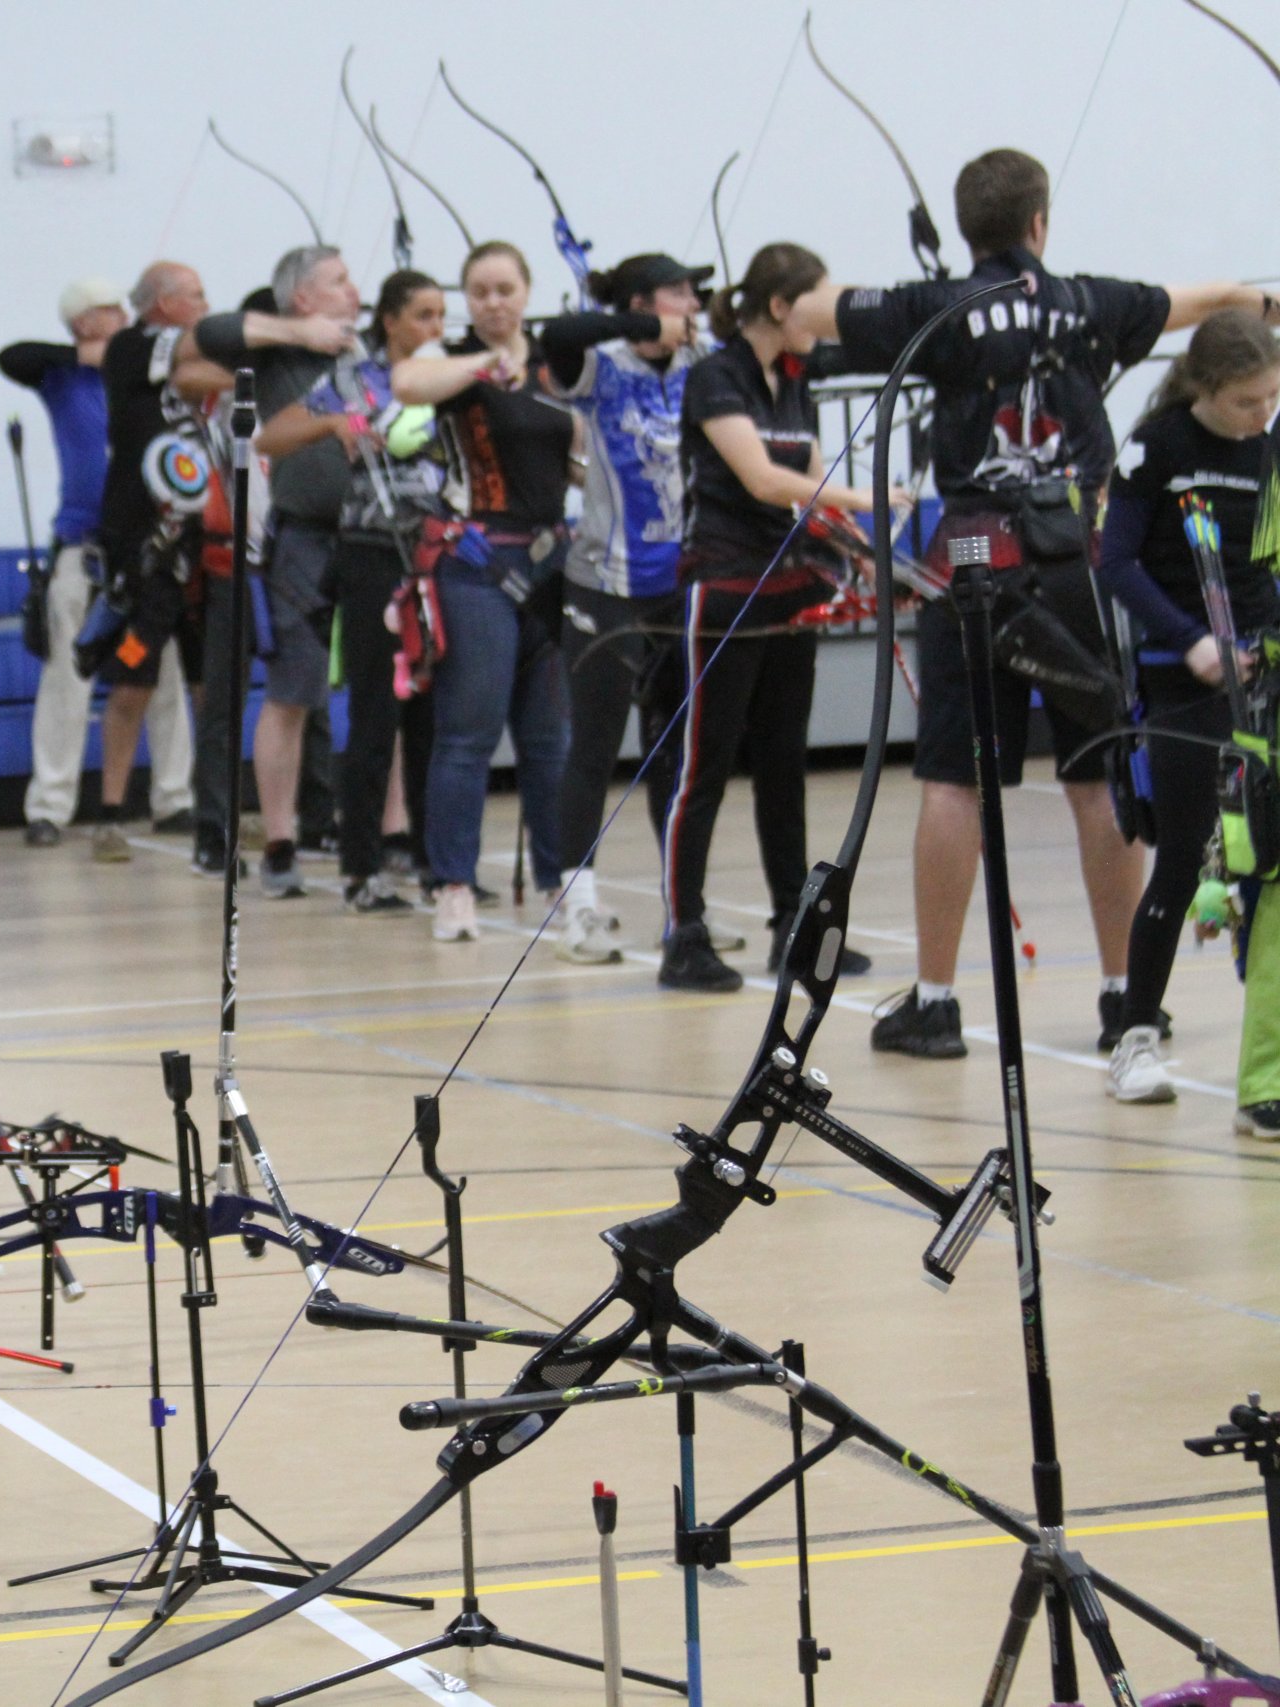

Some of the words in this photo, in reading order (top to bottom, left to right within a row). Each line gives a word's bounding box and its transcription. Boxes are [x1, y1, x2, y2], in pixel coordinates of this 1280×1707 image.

[767, 1086, 790, 1105] THE
[794, 1105, 838, 1137] SYSTEM
[124, 1195, 135, 1235] GTA
[348, 1248, 386, 1272] GTA
